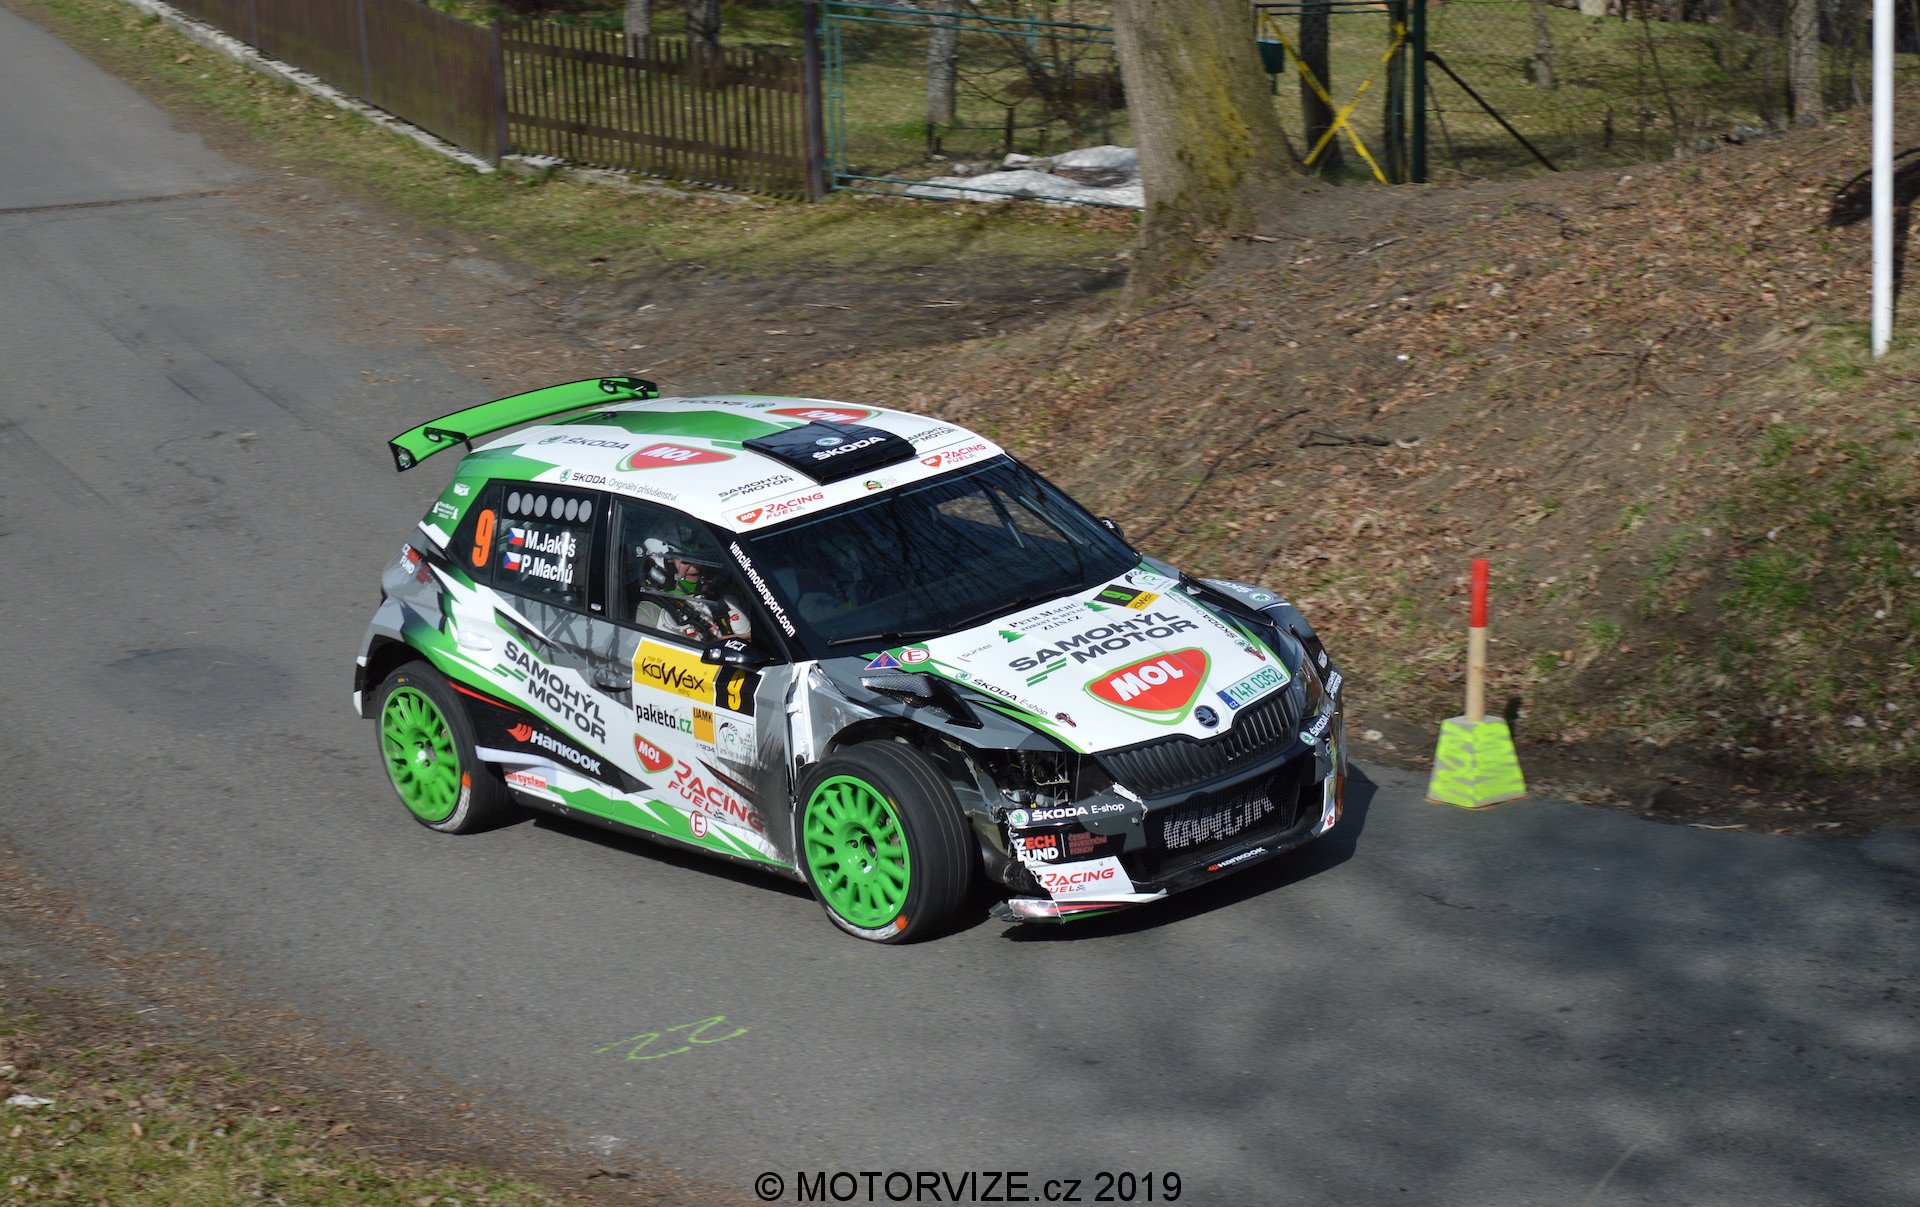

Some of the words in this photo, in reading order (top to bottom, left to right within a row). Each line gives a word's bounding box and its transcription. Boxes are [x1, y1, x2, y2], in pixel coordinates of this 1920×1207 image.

[641, 446, 702, 462] MOL
[941, 444, 987, 459] RACING
[741, 477, 795, 495] MOTOR
[740, 511, 757, 522] MOL
[765, 492, 825, 513] RACING
[471, 508, 496, 567] 9
[520, 553, 574, 585] P.Machů
[1008, 612, 1181, 672] SAMOHÝL
[1070, 620, 1200, 664] MOTOR
[504, 641, 606, 725] SAMOHÝL
[726, 668, 747, 712] 9
[1109, 660, 1184, 702] MOL
[1230, 682, 1257, 701] 14R
[1250, 669, 1284, 690] 0352
[528, 679, 606, 745] MOTOR
[635, 704, 693, 734] paketo.cz
[1020, 698, 1048, 717] E-shop
[638, 741, 661, 764] MOL
[518, 774, 547, 790] system
[668, 779, 711, 815] FUEL
[675, 759, 765, 833] RACING
[1031, 806, 1089, 821] ŠKODA
[1091, 803, 1125, 814] E-shop
[1017, 847, 1059, 862] FUND
[1044, 868, 1115, 887] RACING
